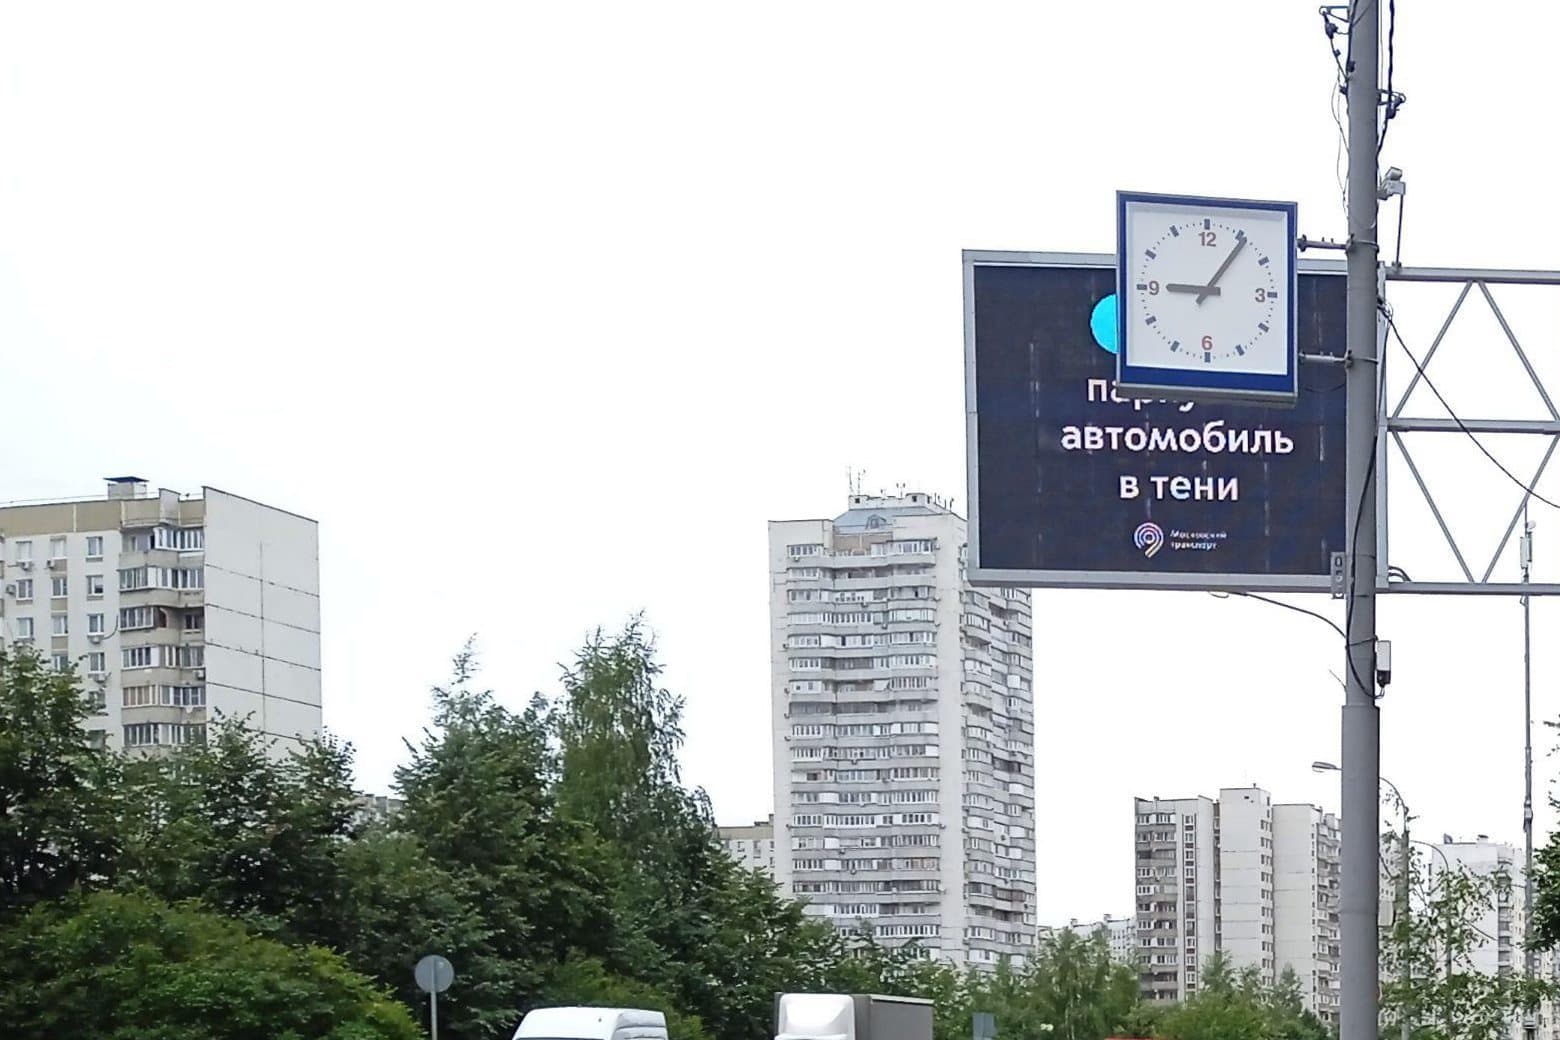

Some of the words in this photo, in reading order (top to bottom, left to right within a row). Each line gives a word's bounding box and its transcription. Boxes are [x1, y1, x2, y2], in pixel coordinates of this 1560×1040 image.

[1198, 231, 1217, 247] 12
[1148, 280, 1160, 296] 9
[1254, 287, 1266, 303] 3
[1201, 335, 1213, 351] 6
[1061, 420, 1294, 453] автомобиль
[1119, 475, 1140, 499] в
[1150, 475, 1239, 501] тени
